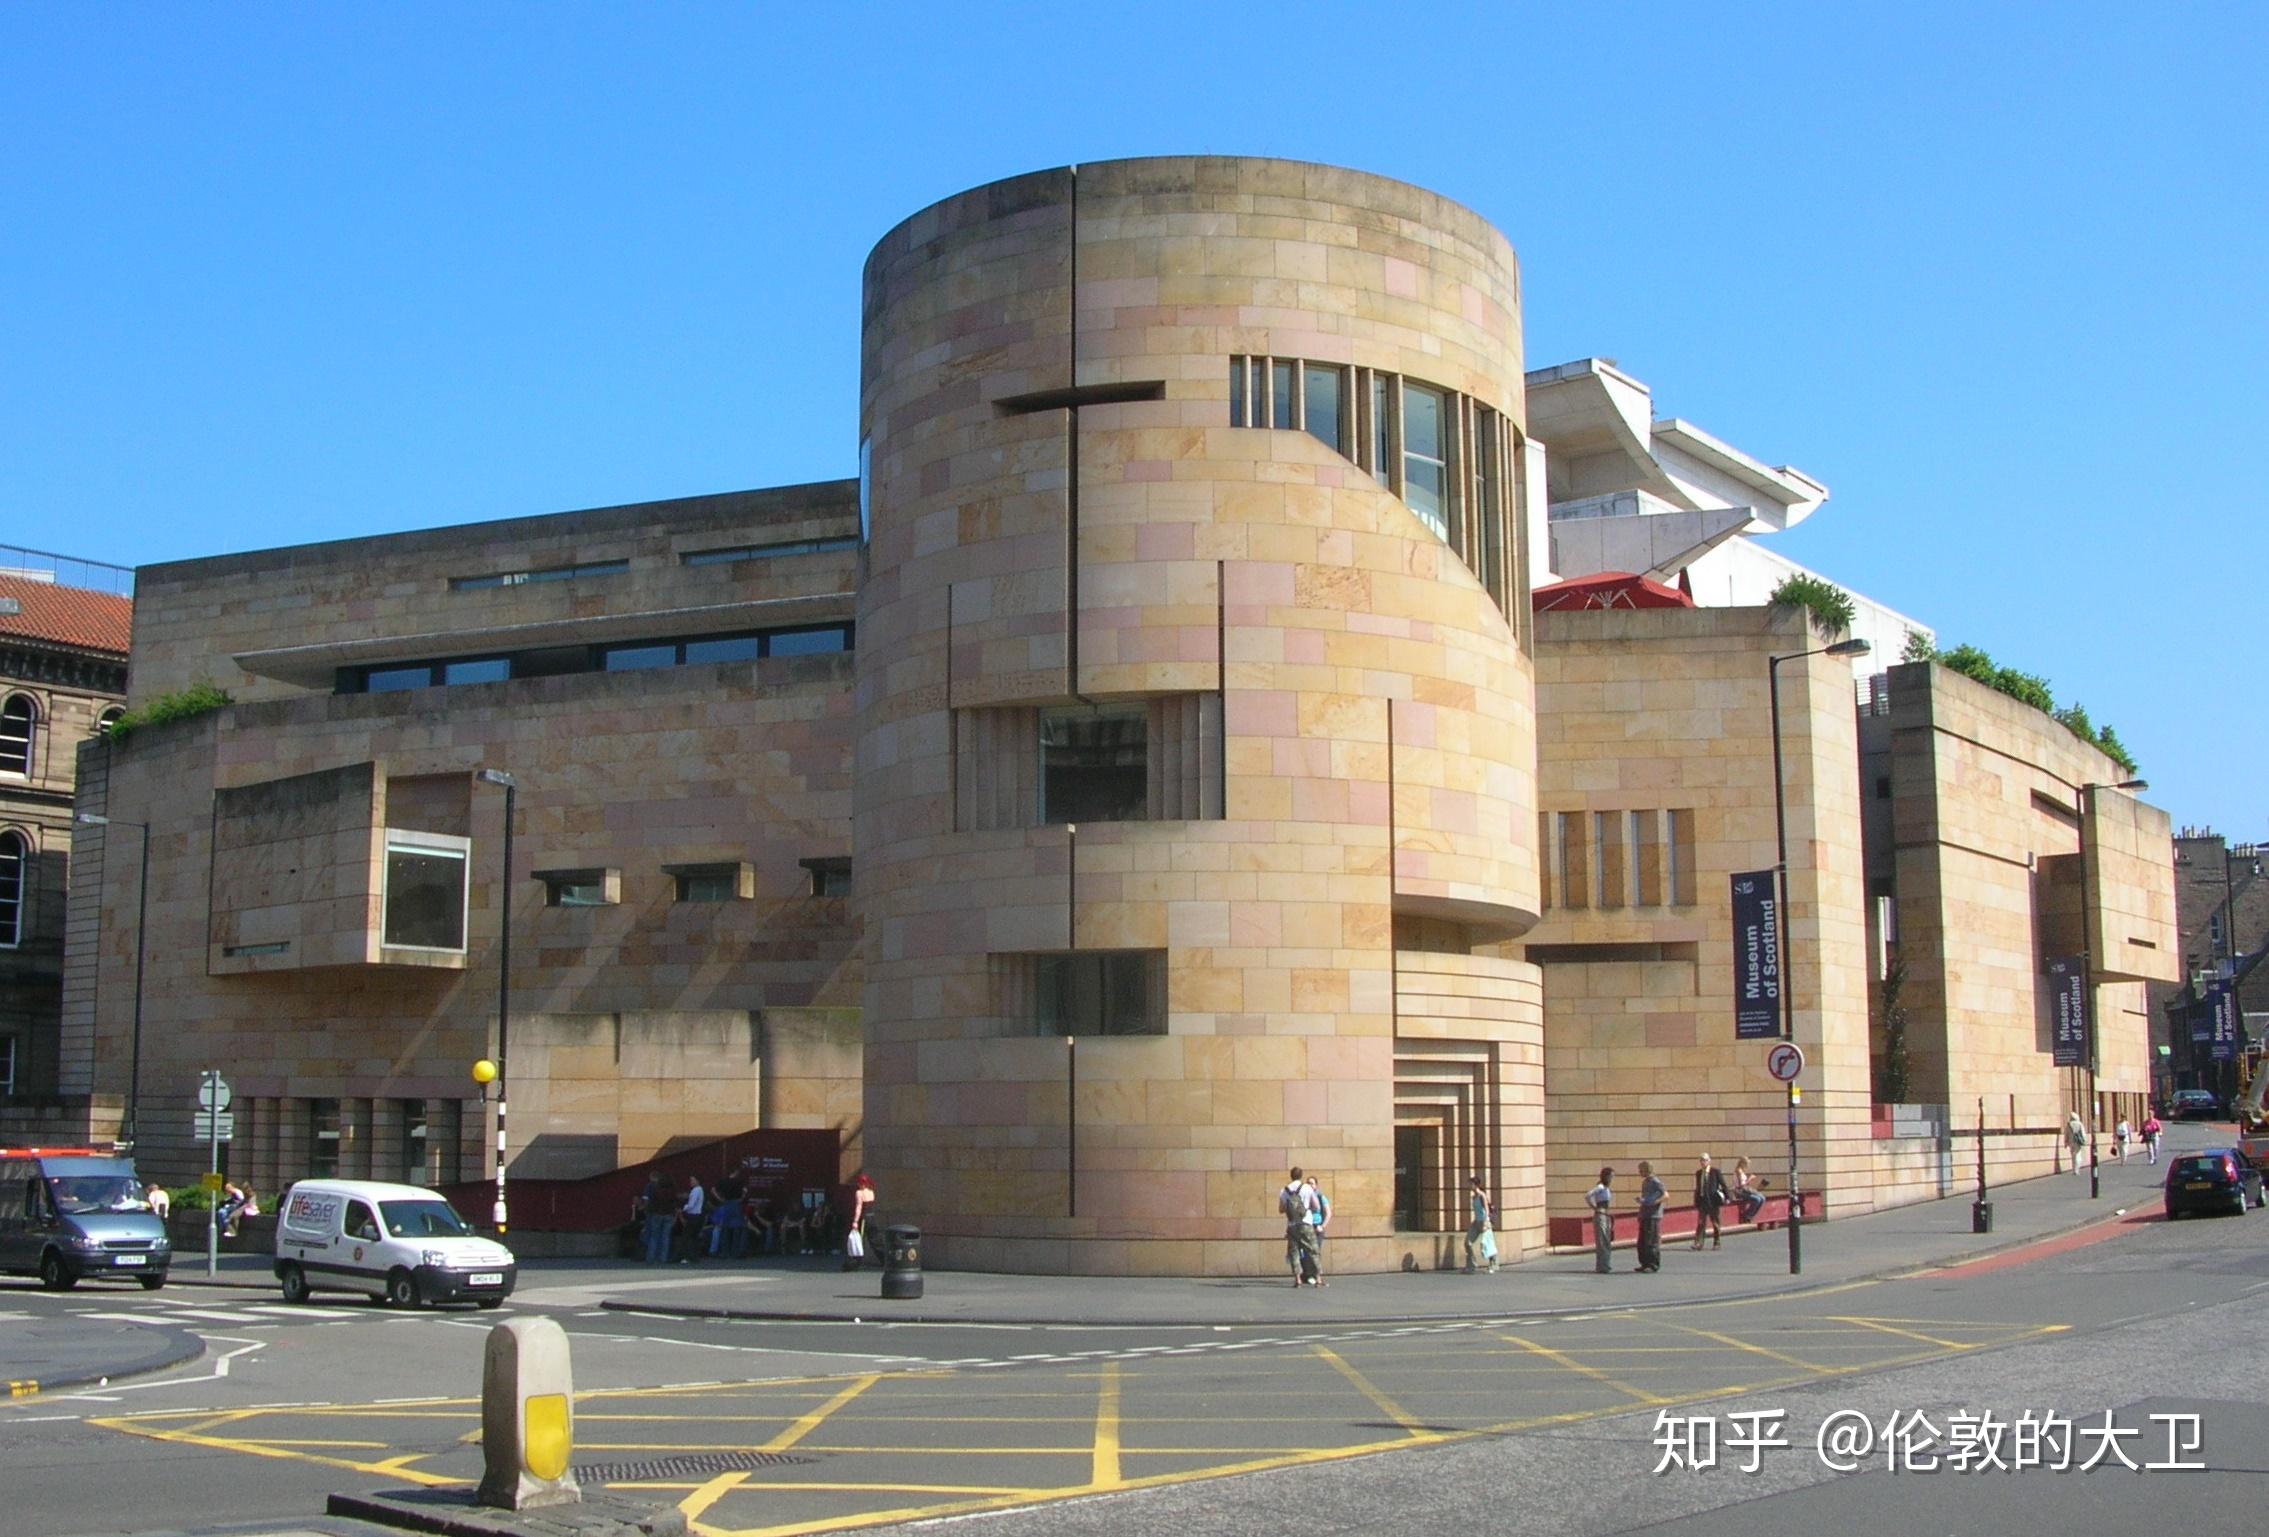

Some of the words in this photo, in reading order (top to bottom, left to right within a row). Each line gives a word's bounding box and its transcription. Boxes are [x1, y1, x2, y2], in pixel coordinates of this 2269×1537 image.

[1761, 900, 1777, 976] Scotland
[1746, 925, 1760, 999] Museum
[1763, 980, 1778, 998] of
[2070, 975, 2082, 1027] Scotland
[2060, 992, 2070, 1041] Museum
[2215, 1004, 2223, 1041] Museum
[2223, 992, 2233, 1030] Scotland
[2072, 1029, 2083, 1041] of
